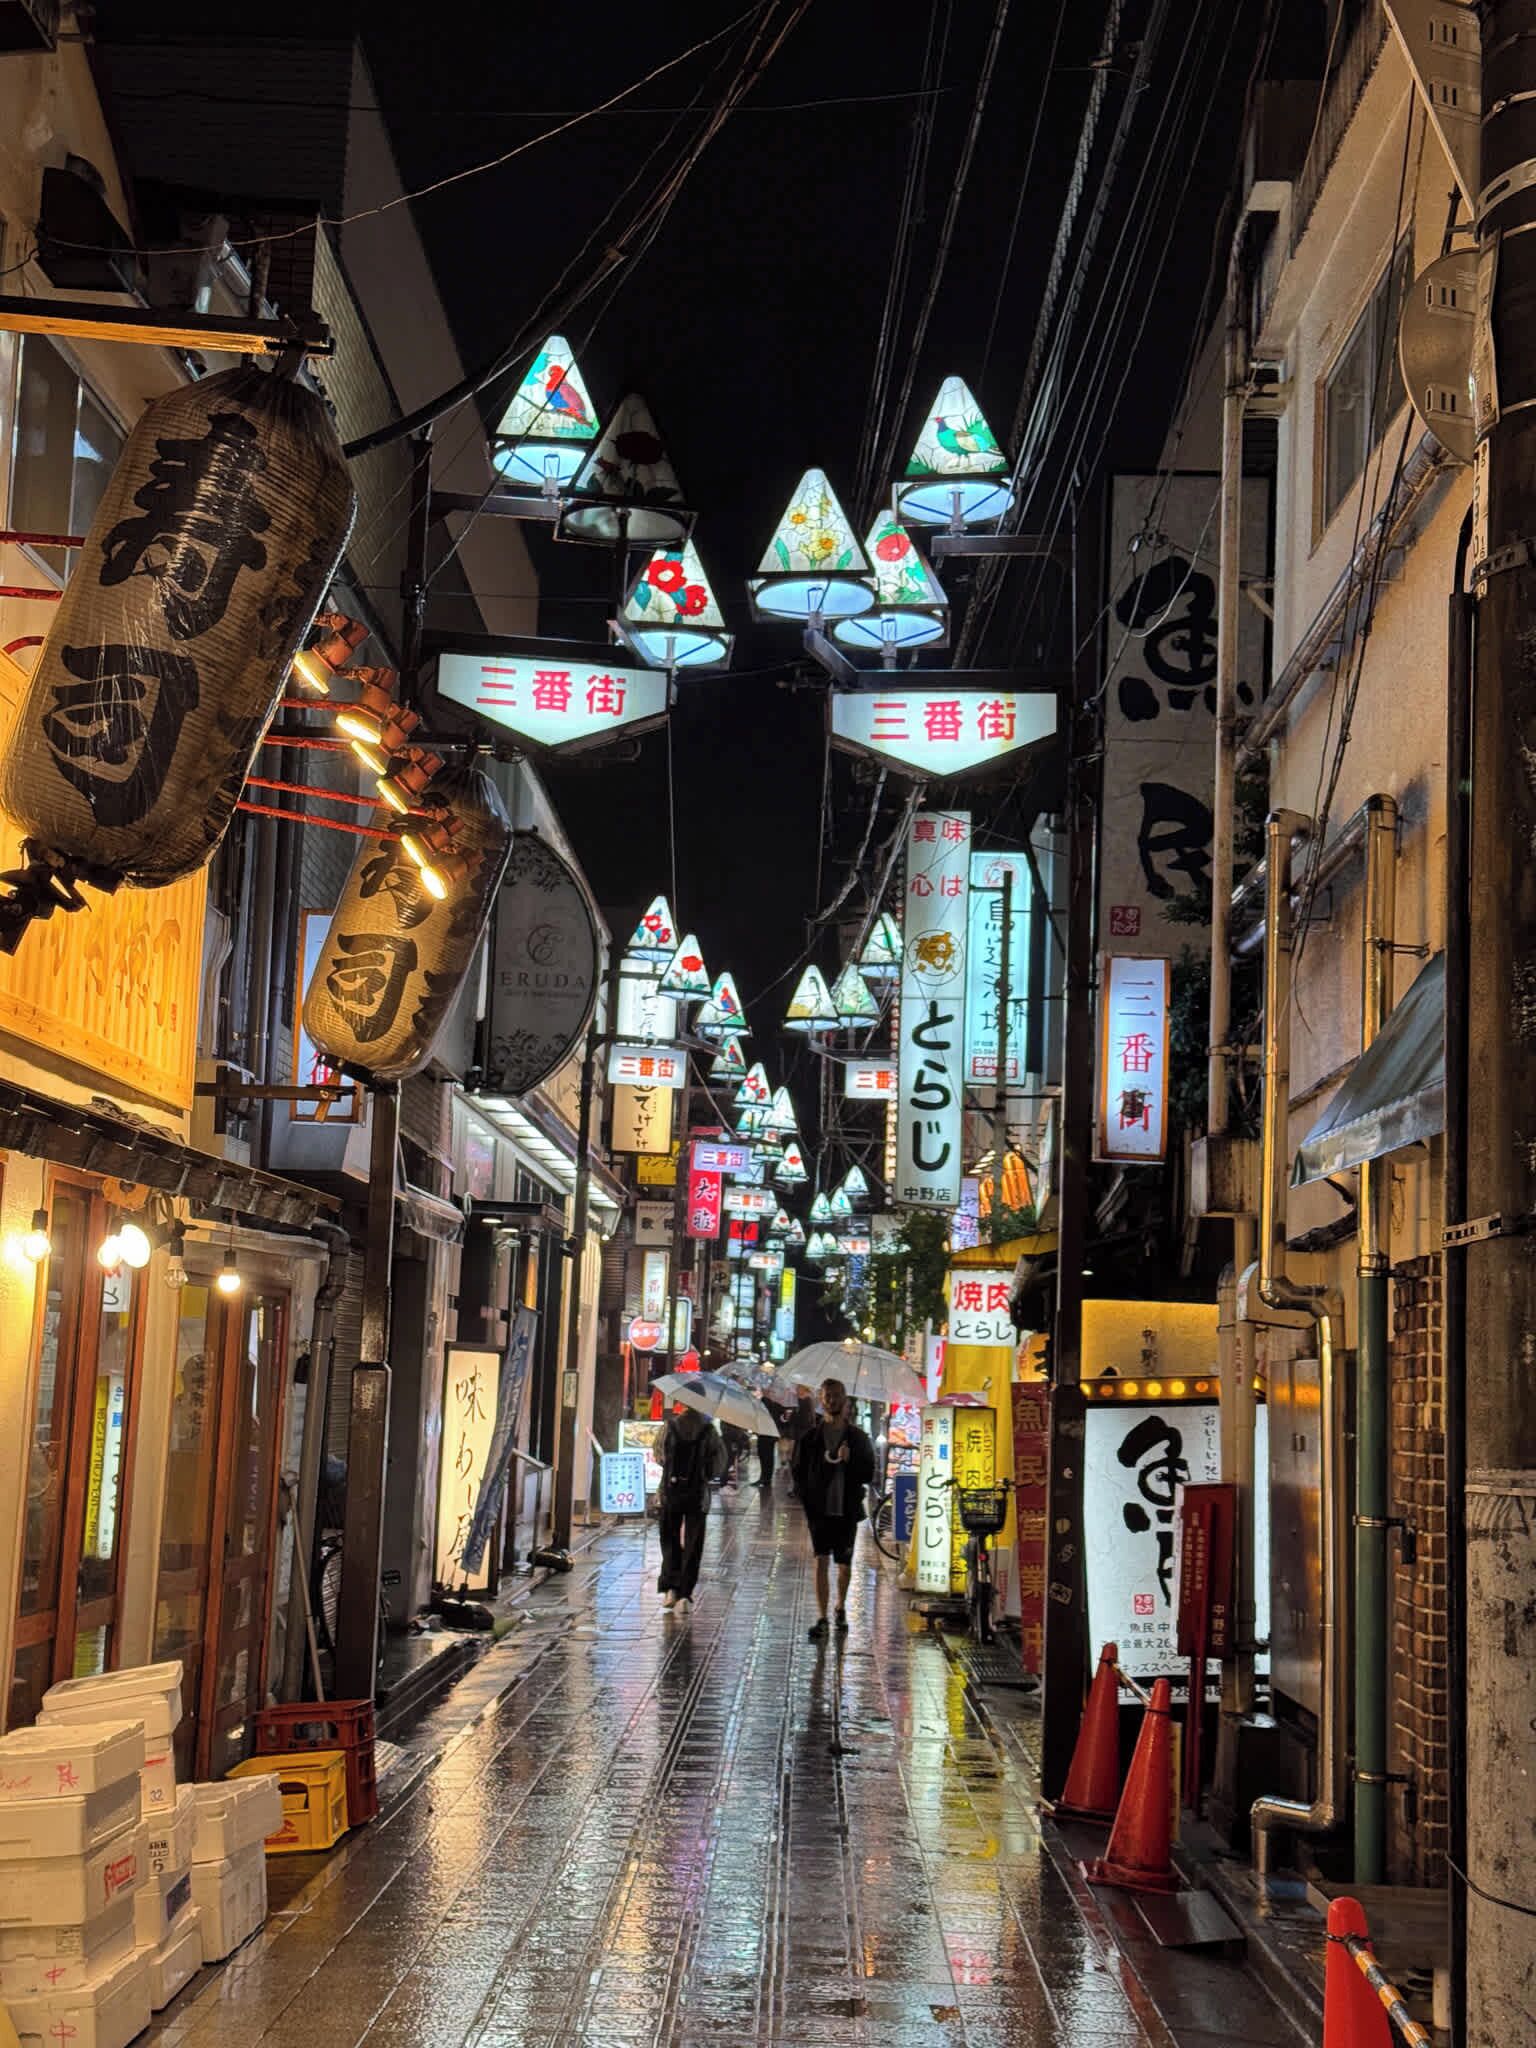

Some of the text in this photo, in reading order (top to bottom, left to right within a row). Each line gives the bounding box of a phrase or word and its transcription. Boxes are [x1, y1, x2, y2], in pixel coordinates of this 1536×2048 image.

[476, 665, 626, 716] 三番街
[870, 700, 1016, 742] 三番街
[500, 971, 586, 990] ERUDA
[910, 1000, 955, 1172] とらじ
[904, 1187, 952, 1202] 中野店
[954, 1280, 1010, 1313] 焼肉
[955, 1319, 1013, 1341] とらじ
[926, 1467, 946, 1549] とらじ
